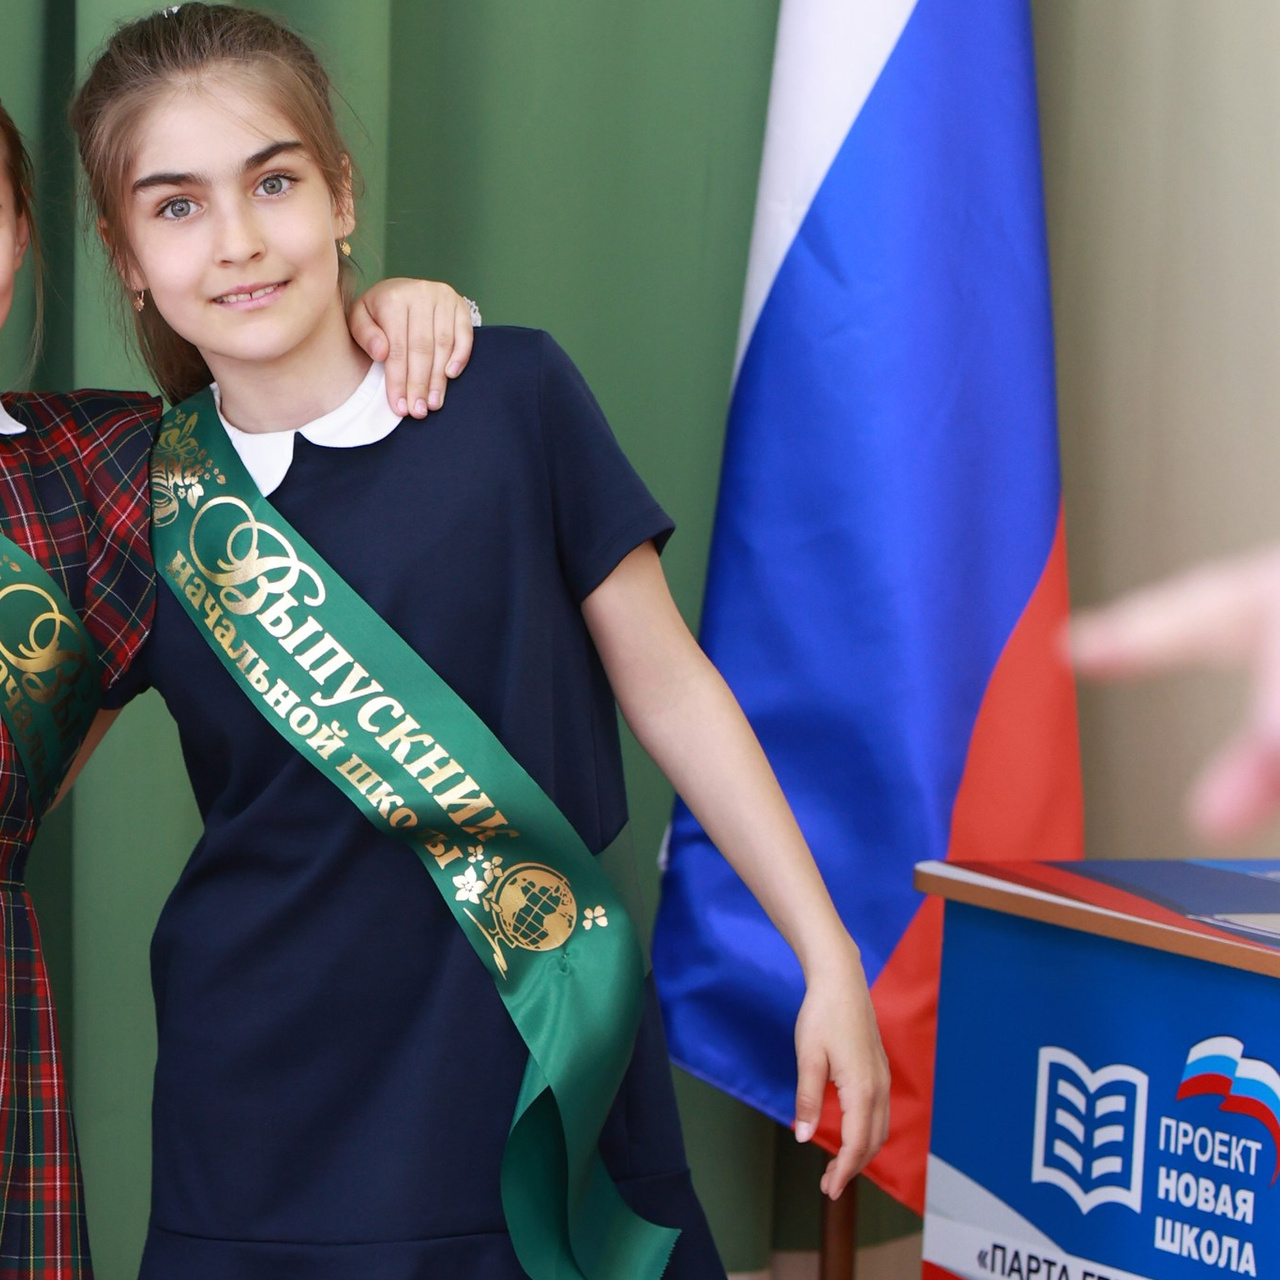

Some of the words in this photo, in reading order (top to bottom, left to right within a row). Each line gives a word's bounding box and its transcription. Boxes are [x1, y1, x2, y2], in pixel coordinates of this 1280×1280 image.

[165, 549, 345, 758] начальной
[1158, 1116, 1263, 1176] ПРОЕКТ
[1157, 1166, 1255, 1225] НОВАЯ
[1153, 1216, 1257, 1278] ШКОЛА
